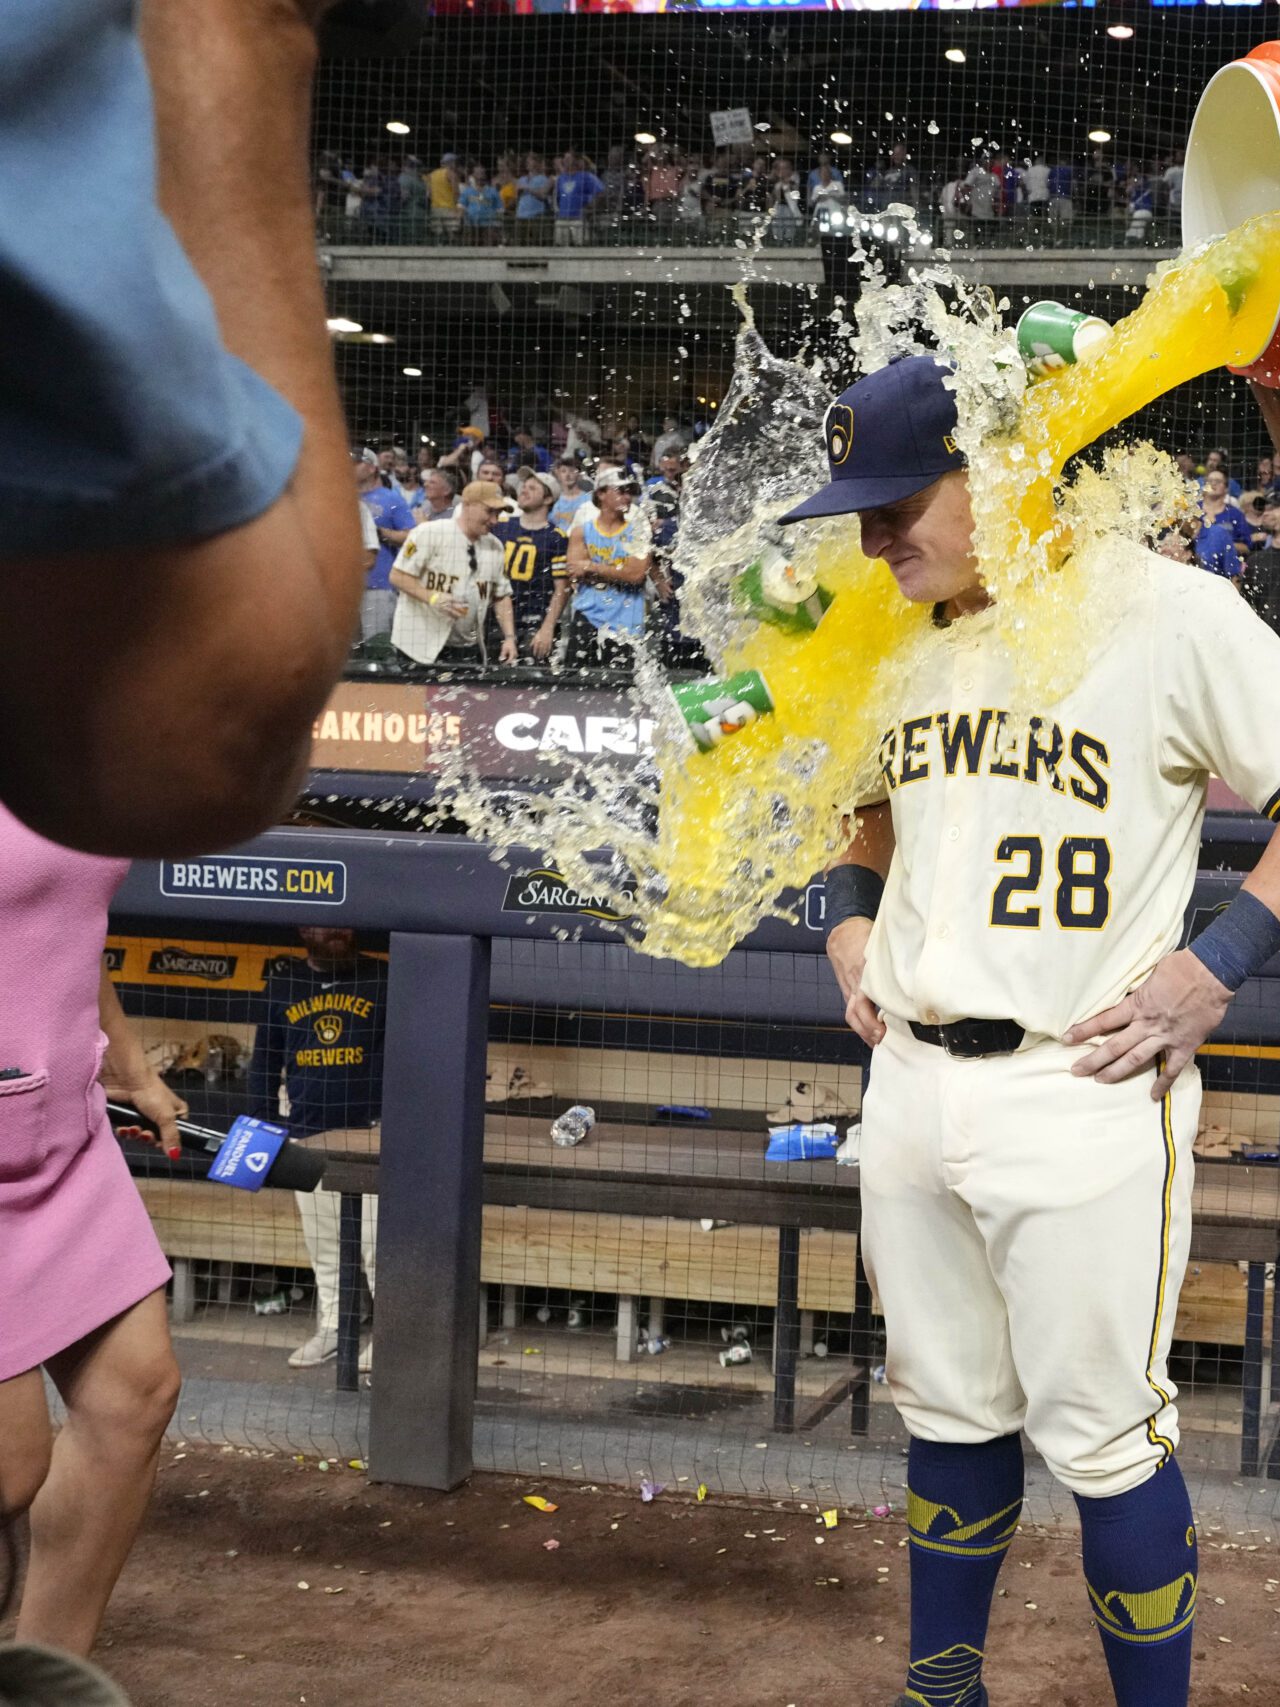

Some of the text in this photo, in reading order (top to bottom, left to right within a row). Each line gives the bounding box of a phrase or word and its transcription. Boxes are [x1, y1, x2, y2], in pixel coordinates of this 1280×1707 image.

[314, 711, 461, 745] AKHOUSE
[172, 863, 335, 895] BREWERS.COM
[988, 834, 1113, 931] 28
[285, 993, 374, 1025] MILWAUKEE
[296, 1046, 363, 1067] BREWERS
[220, 1130, 253, 1178] FANDUEL
